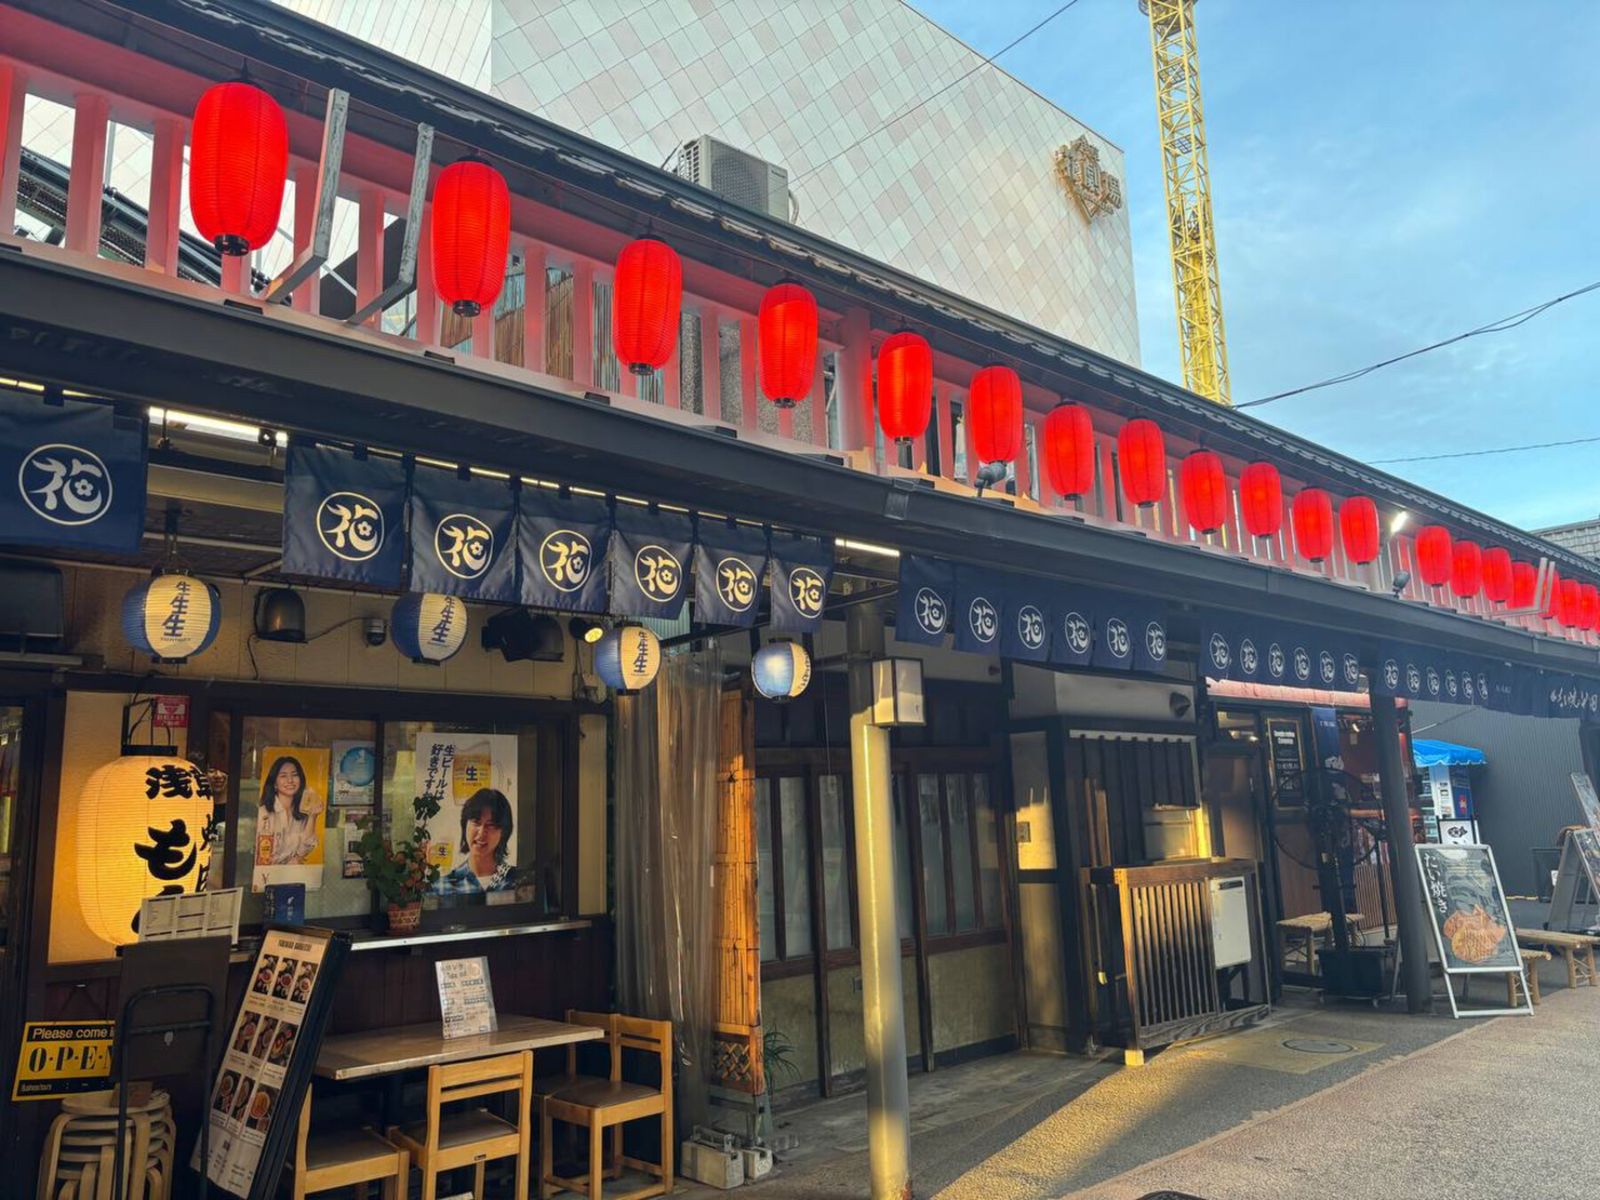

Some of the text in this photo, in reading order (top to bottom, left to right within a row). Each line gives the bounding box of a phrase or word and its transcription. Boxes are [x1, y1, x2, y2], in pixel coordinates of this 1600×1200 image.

[161, 581, 191, 637] 生生生
[432, 596, 455, 642] 生生生
[435, 745, 456, 800] 生ビールは
[465, 766, 478, 781] 生
[32, 1028, 73, 1039] Please
[76, 1028, 107, 1038] come
